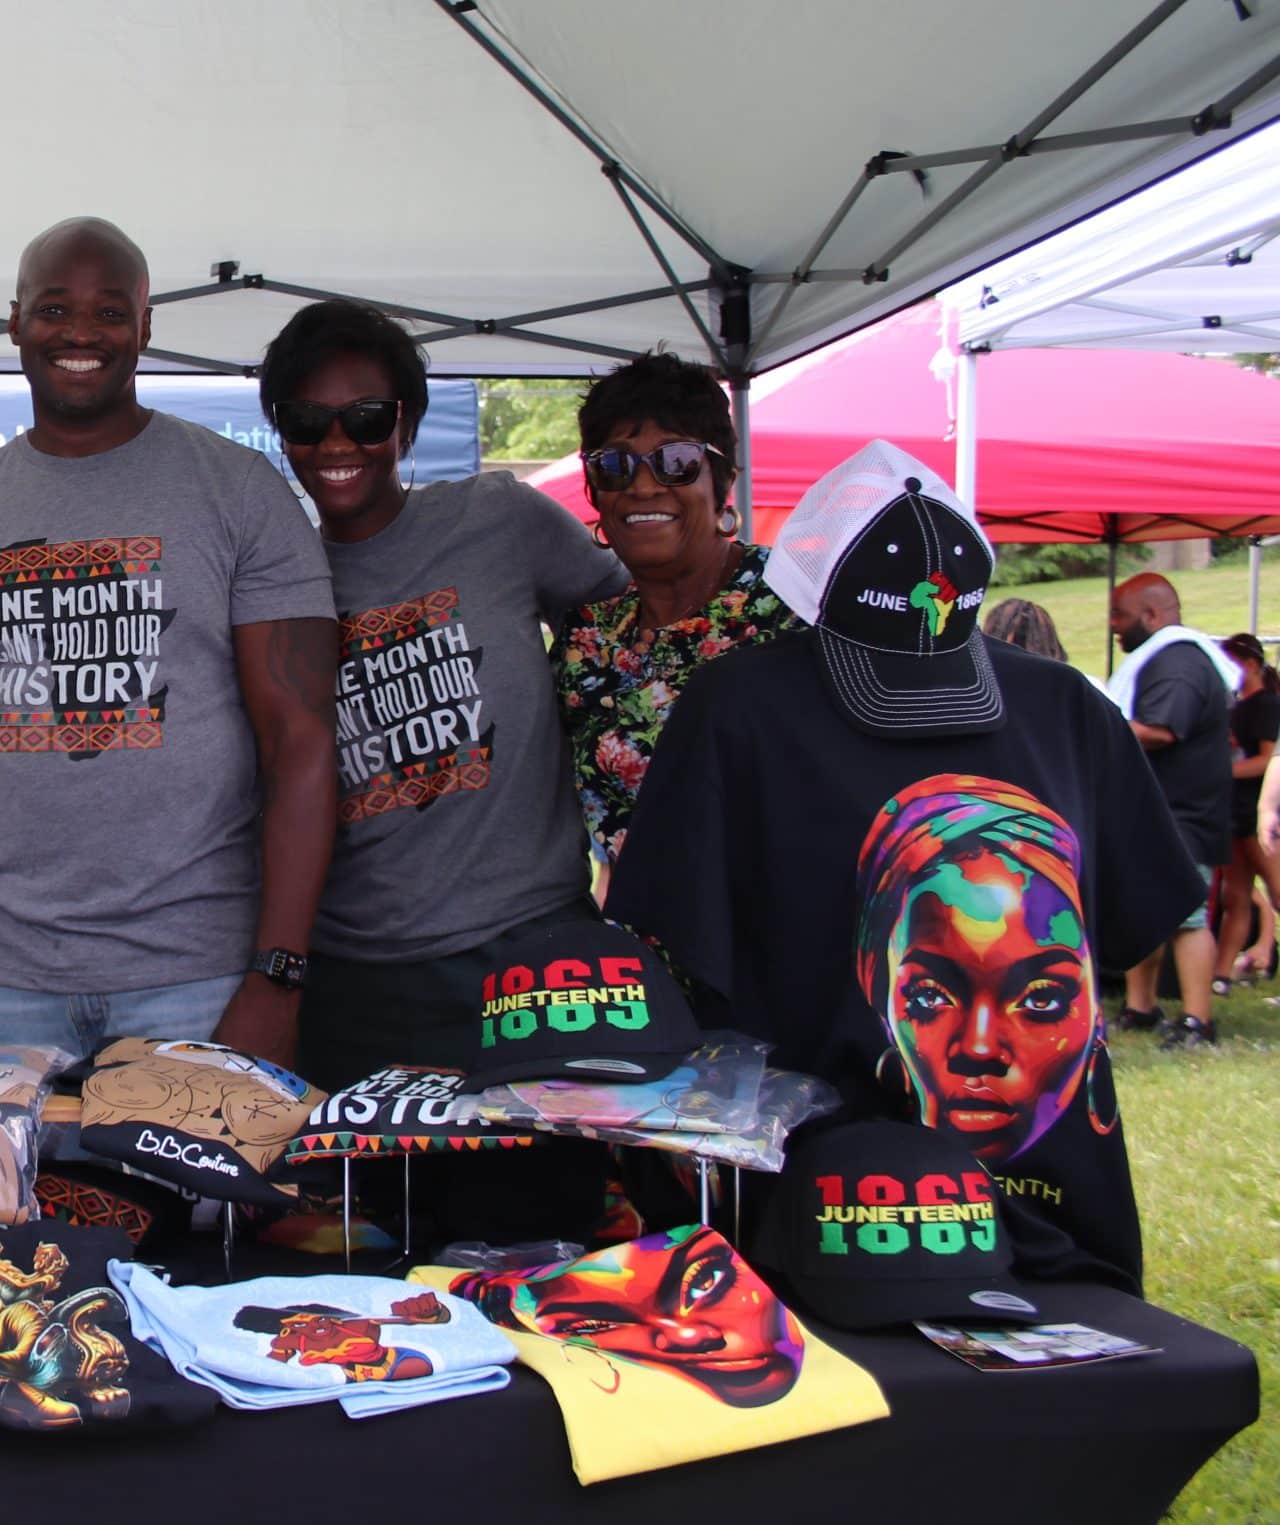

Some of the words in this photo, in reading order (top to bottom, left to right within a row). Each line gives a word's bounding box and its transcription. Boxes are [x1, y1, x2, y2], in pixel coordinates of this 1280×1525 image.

[52, 579, 163, 619] MONTH
[856, 588, 909, 612] JUNE
[955, 588, 985, 611] 1865
[52, 618, 109, 661] HOLD
[115, 613, 161, 657] OUR
[363, 623, 470, 684] MONTH
[371, 672, 428, 726] HOLD
[428, 656, 480, 700] OUR
[337, 700, 483, 788] HISTORY
[481, 985, 646, 1017] JUNETEENTH
[816, 1202, 994, 1224] JUNETEENTH
